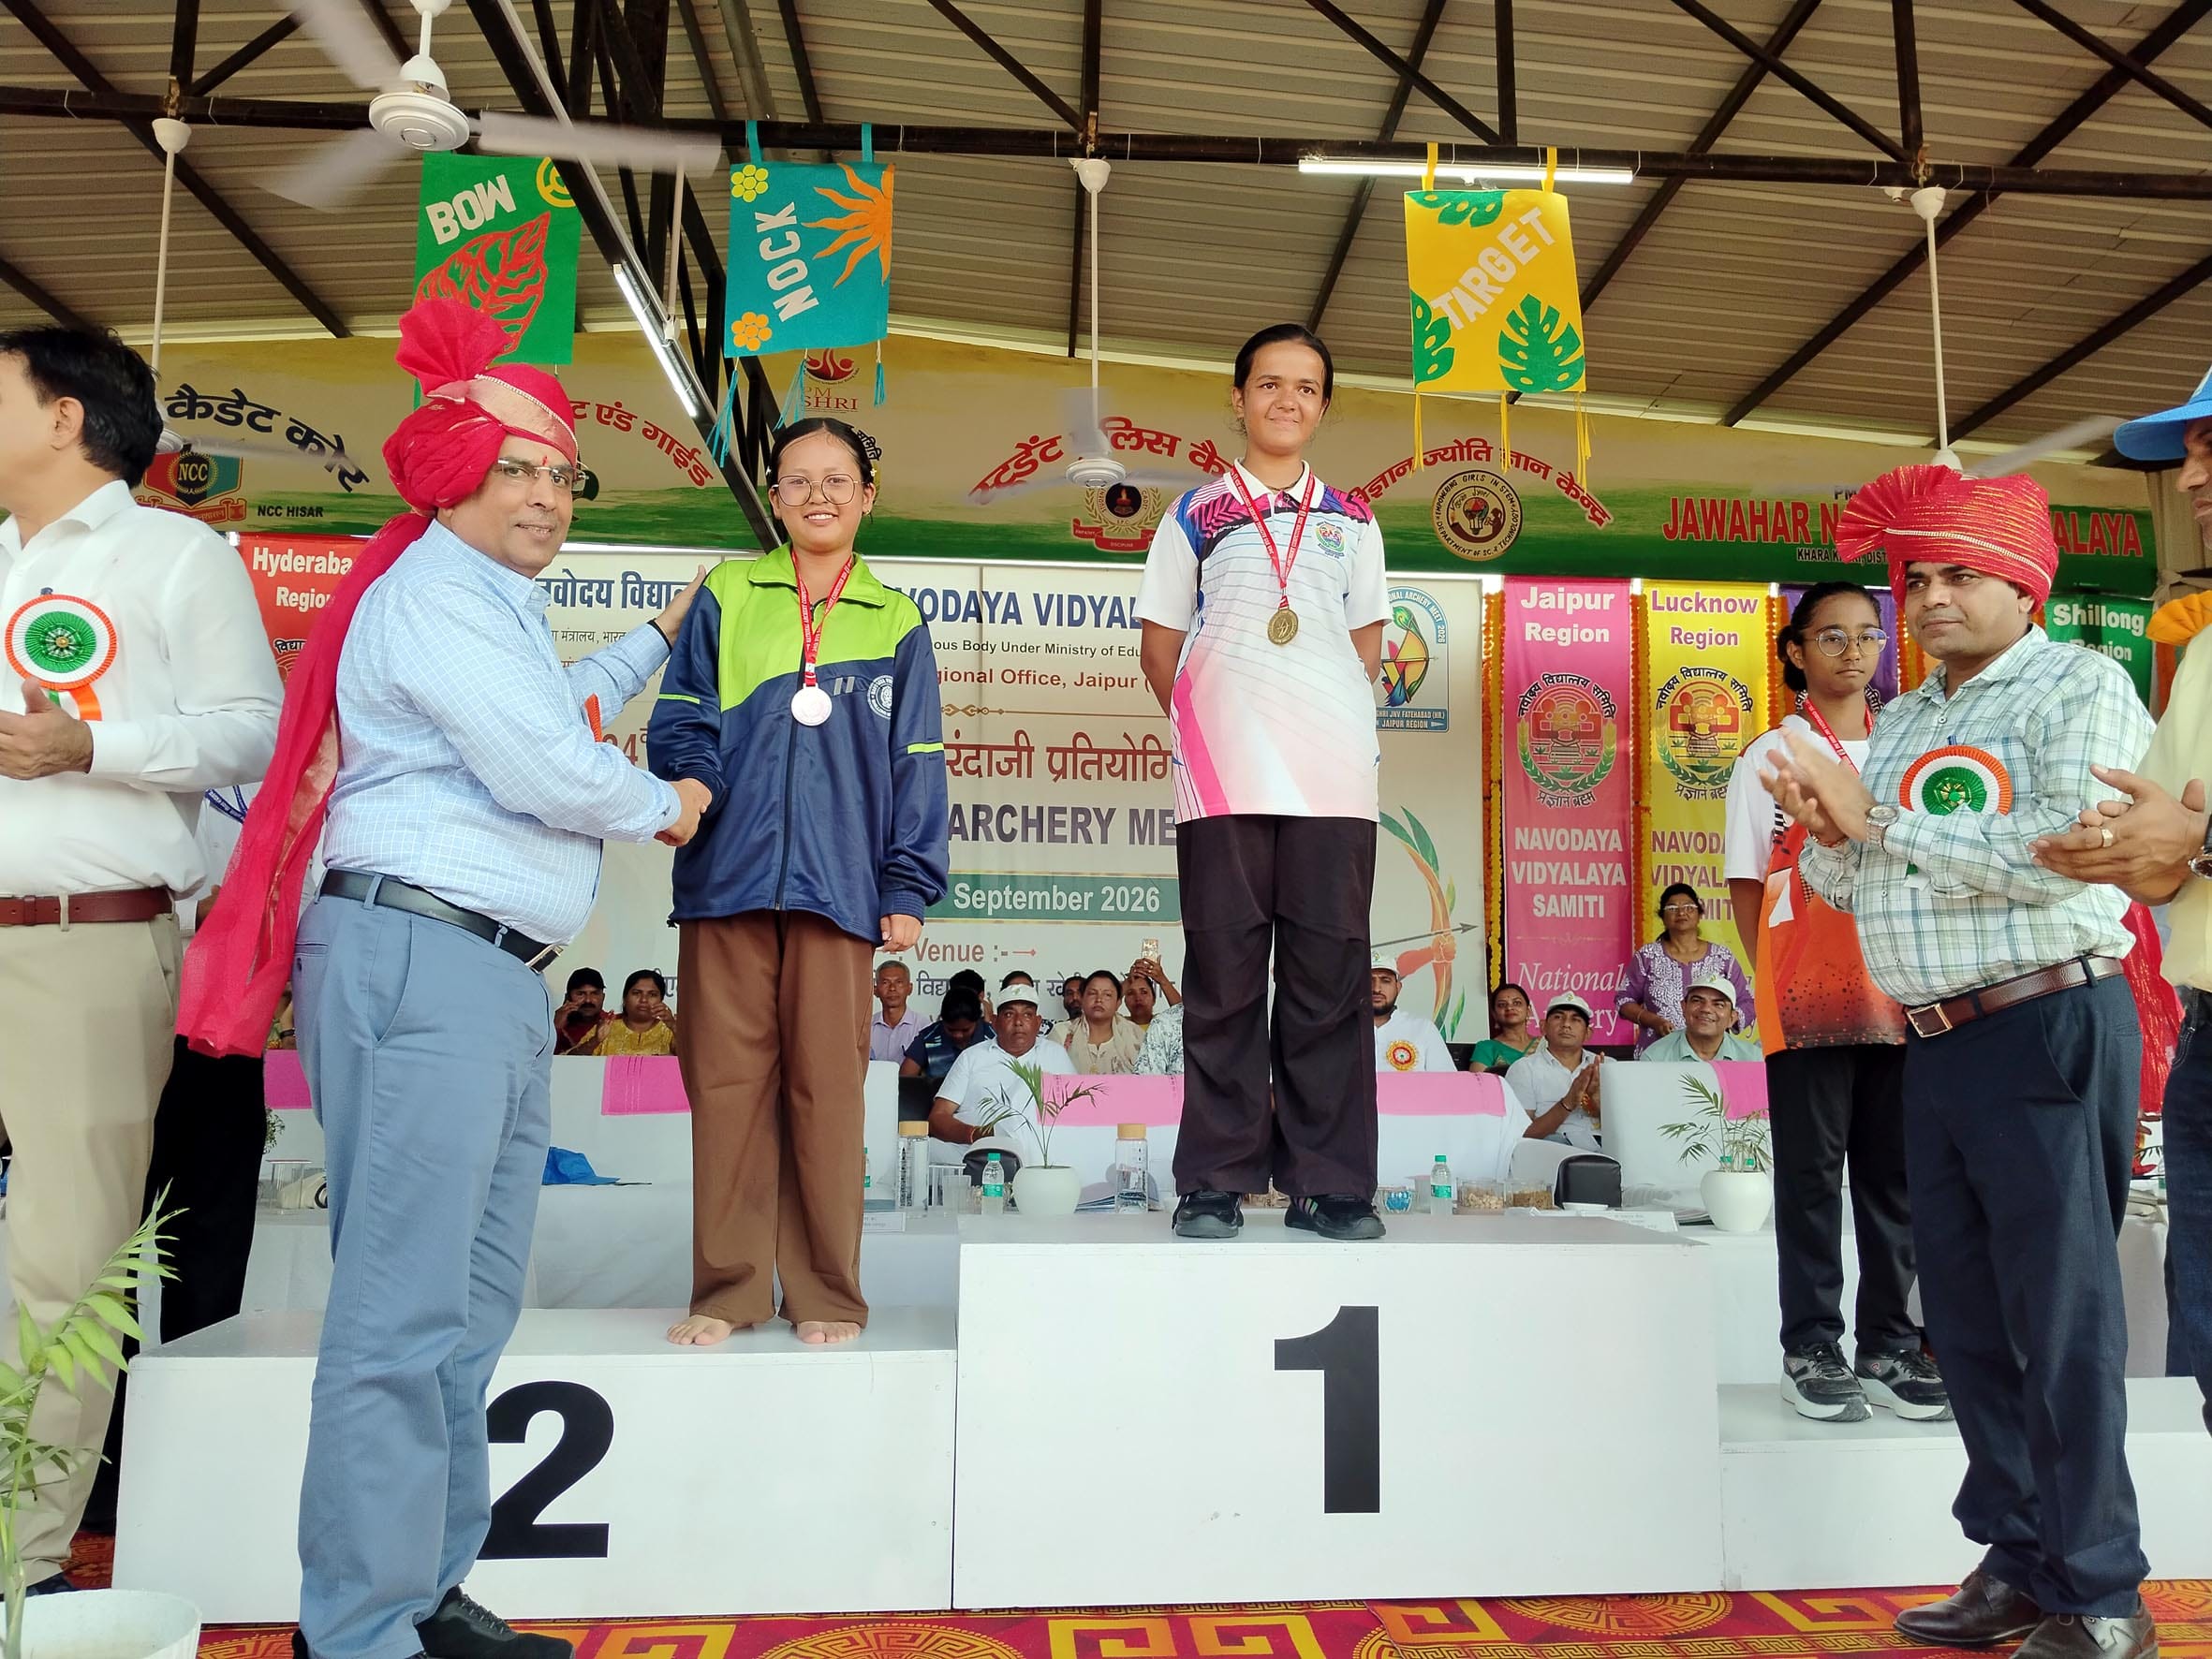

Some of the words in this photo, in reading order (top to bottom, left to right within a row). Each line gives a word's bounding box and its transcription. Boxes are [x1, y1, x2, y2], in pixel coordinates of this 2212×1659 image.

[425, 174, 517, 244] BOW
[756, 202, 819, 322] NOCK
[1429, 206, 1556, 330] TARGET
[165, 383, 281, 433] कैडेट
[596, 401, 638, 433] एंड
[641, 420, 714, 487] गाईड
[178, 462, 208, 482] NCC
[1462, 474, 1486, 482] GIRLS
[1490, 478, 1499, 487] IN
[258, 506, 283, 518] NCC
[287, 507, 324, 518] HISAR
[1662, 497, 1813, 545] JAWAHAR
[2050, 511, 2144, 557] ALAYA
[253, 547, 353, 577] Hyderaba
[1797, 548, 1830, 562] KHARA
[1033, 592, 1143, 630] VIDYAL
[1405, 591, 1431, 609] ARCHERY
[1521, 586, 1615, 614] Jaipur
[1651, 590, 1759, 614] Lucknow
[1525, 622, 1610, 646] Region
[2053, 604, 2145, 637] Shillong
[963, 639, 996, 654] Body
[1001, 641, 1040, 654] Under
[1044, 643, 1096, 658] Ministry
[1100, 644, 1114, 656] of
[1670, 626, 1738, 650] Region
[936, 667, 994, 685] gional
[1001, 668, 1067, 689] Office,
[1073, 671, 1138, 691] Jaipur
[1381, 719, 1405, 728] JAIPUR
[1406, 720, 1428, 728] REGION
[944, 728, 1035, 779] रंदाजी
[948, 803, 1117, 844] ARCHERY
[1128, 808, 1177, 846] ME
[1514, 827, 1623, 852] NAVODAYA
[1512, 861, 1626, 886] VIDYALAYA
[953, 882, 1094, 916] September
[1100, 886, 1160, 913] 2026
[1533, 894, 1605, 918] SAMITI
[915, 937, 984, 962] Venue
[1518, 962, 1625, 991] National
[1275, 1305, 1380, 1514] 1
[477, 1381, 614, 1560] 2
